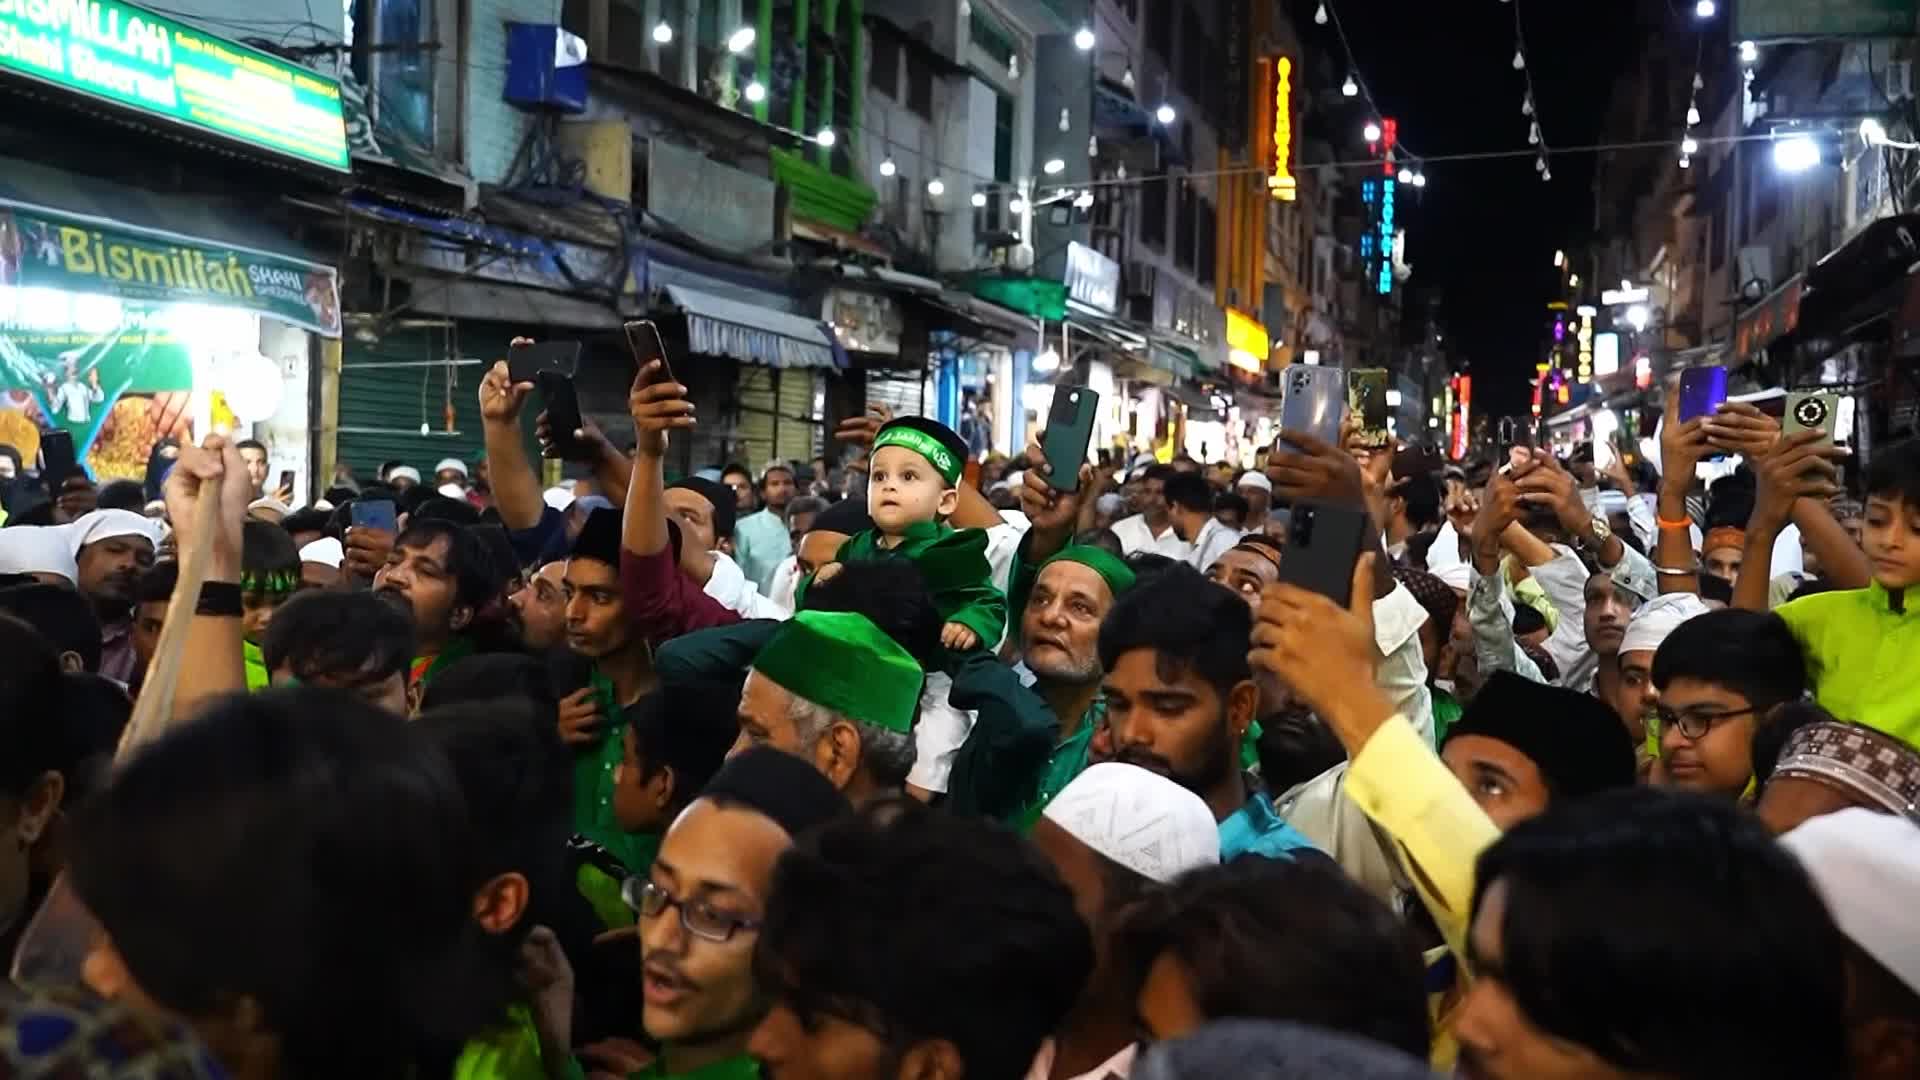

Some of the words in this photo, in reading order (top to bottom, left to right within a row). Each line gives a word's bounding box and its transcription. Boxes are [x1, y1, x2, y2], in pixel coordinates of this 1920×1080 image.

[0, 0, 171, 66] SMILLAH
[59, 226, 254, 297] Bismillah
[248, 264, 303, 291] SHAHI
